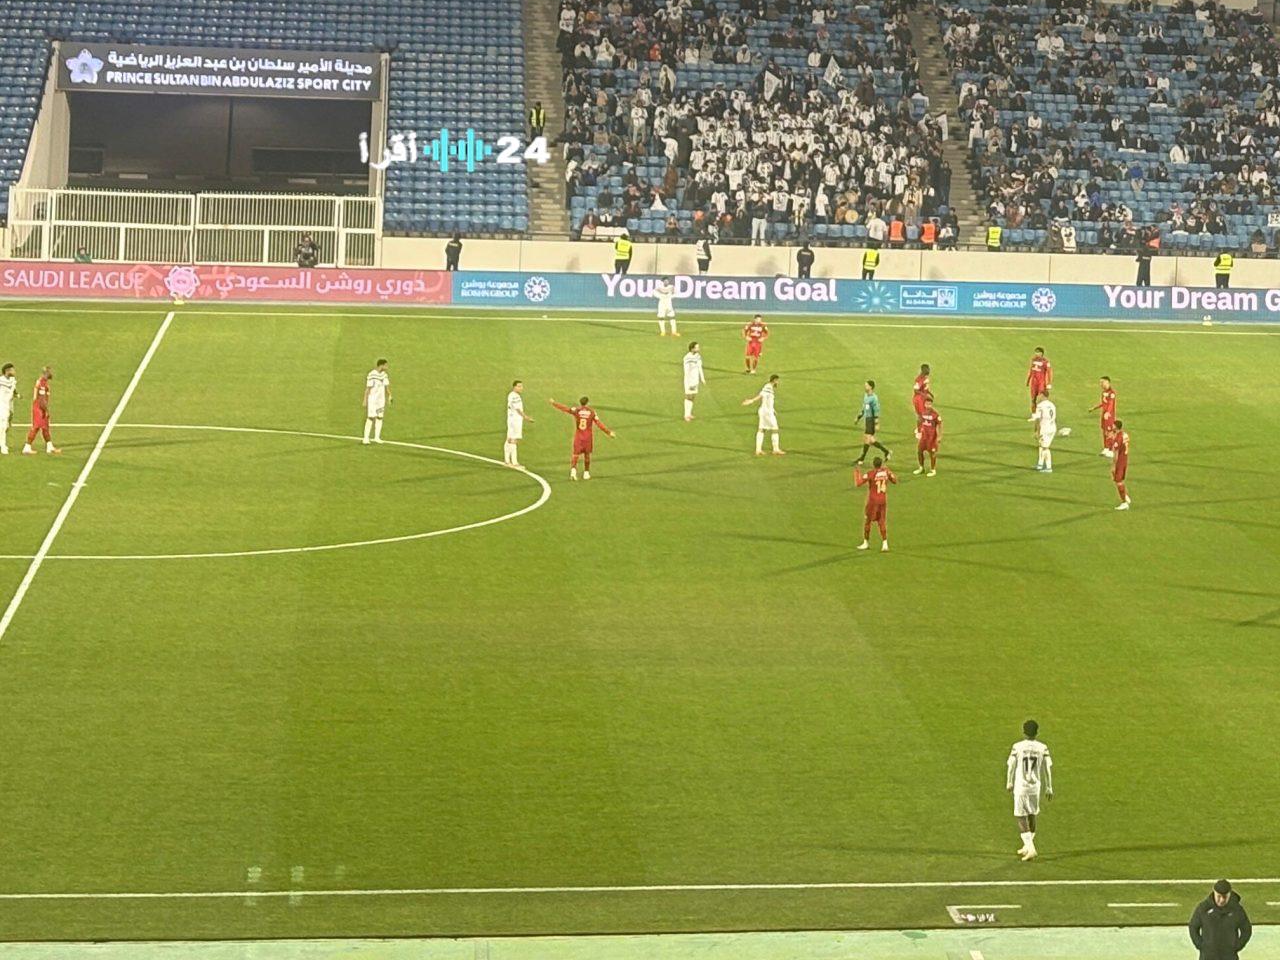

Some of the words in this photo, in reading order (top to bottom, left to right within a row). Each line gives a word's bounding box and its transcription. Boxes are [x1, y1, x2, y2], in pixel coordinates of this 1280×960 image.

[108, 51, 163, 68] الرياضية
[164, 55, 202, 70] العزيز
[204, 57, 227, 71] عبد
[229, 57, 246, 72] بن
[248, 57, 295, 71] سلطان
[298, 58, 332, 74] الأمير
[335, 59, 373, 76] مدينة
[107, 71, 152, 85] PRINCE
[153, 73, 199, 86] SULTAN
[201, 75, 221, 87] BIN
[223, 76, 295, 89] ABDULAZIZ
[297, 78, 339, 90] SPORT
[342, 79, 371, 91] CITY
[4, 269, 64, 288] SAUDI
[70, 271, 144, 290] LEAGUE
[216, 271, 311, 299] السعودي
[316, 272, 371, 294] روشن
[376, 278, 425, 299] دوري
[674, 275, 766, 300] Dream
[774, 277, 838, 302] Goal
[1103, 286, 1165, 309] Your
[1171, 287, 1258, 311] Dream
[1023, 756, 1038, 771] 17
